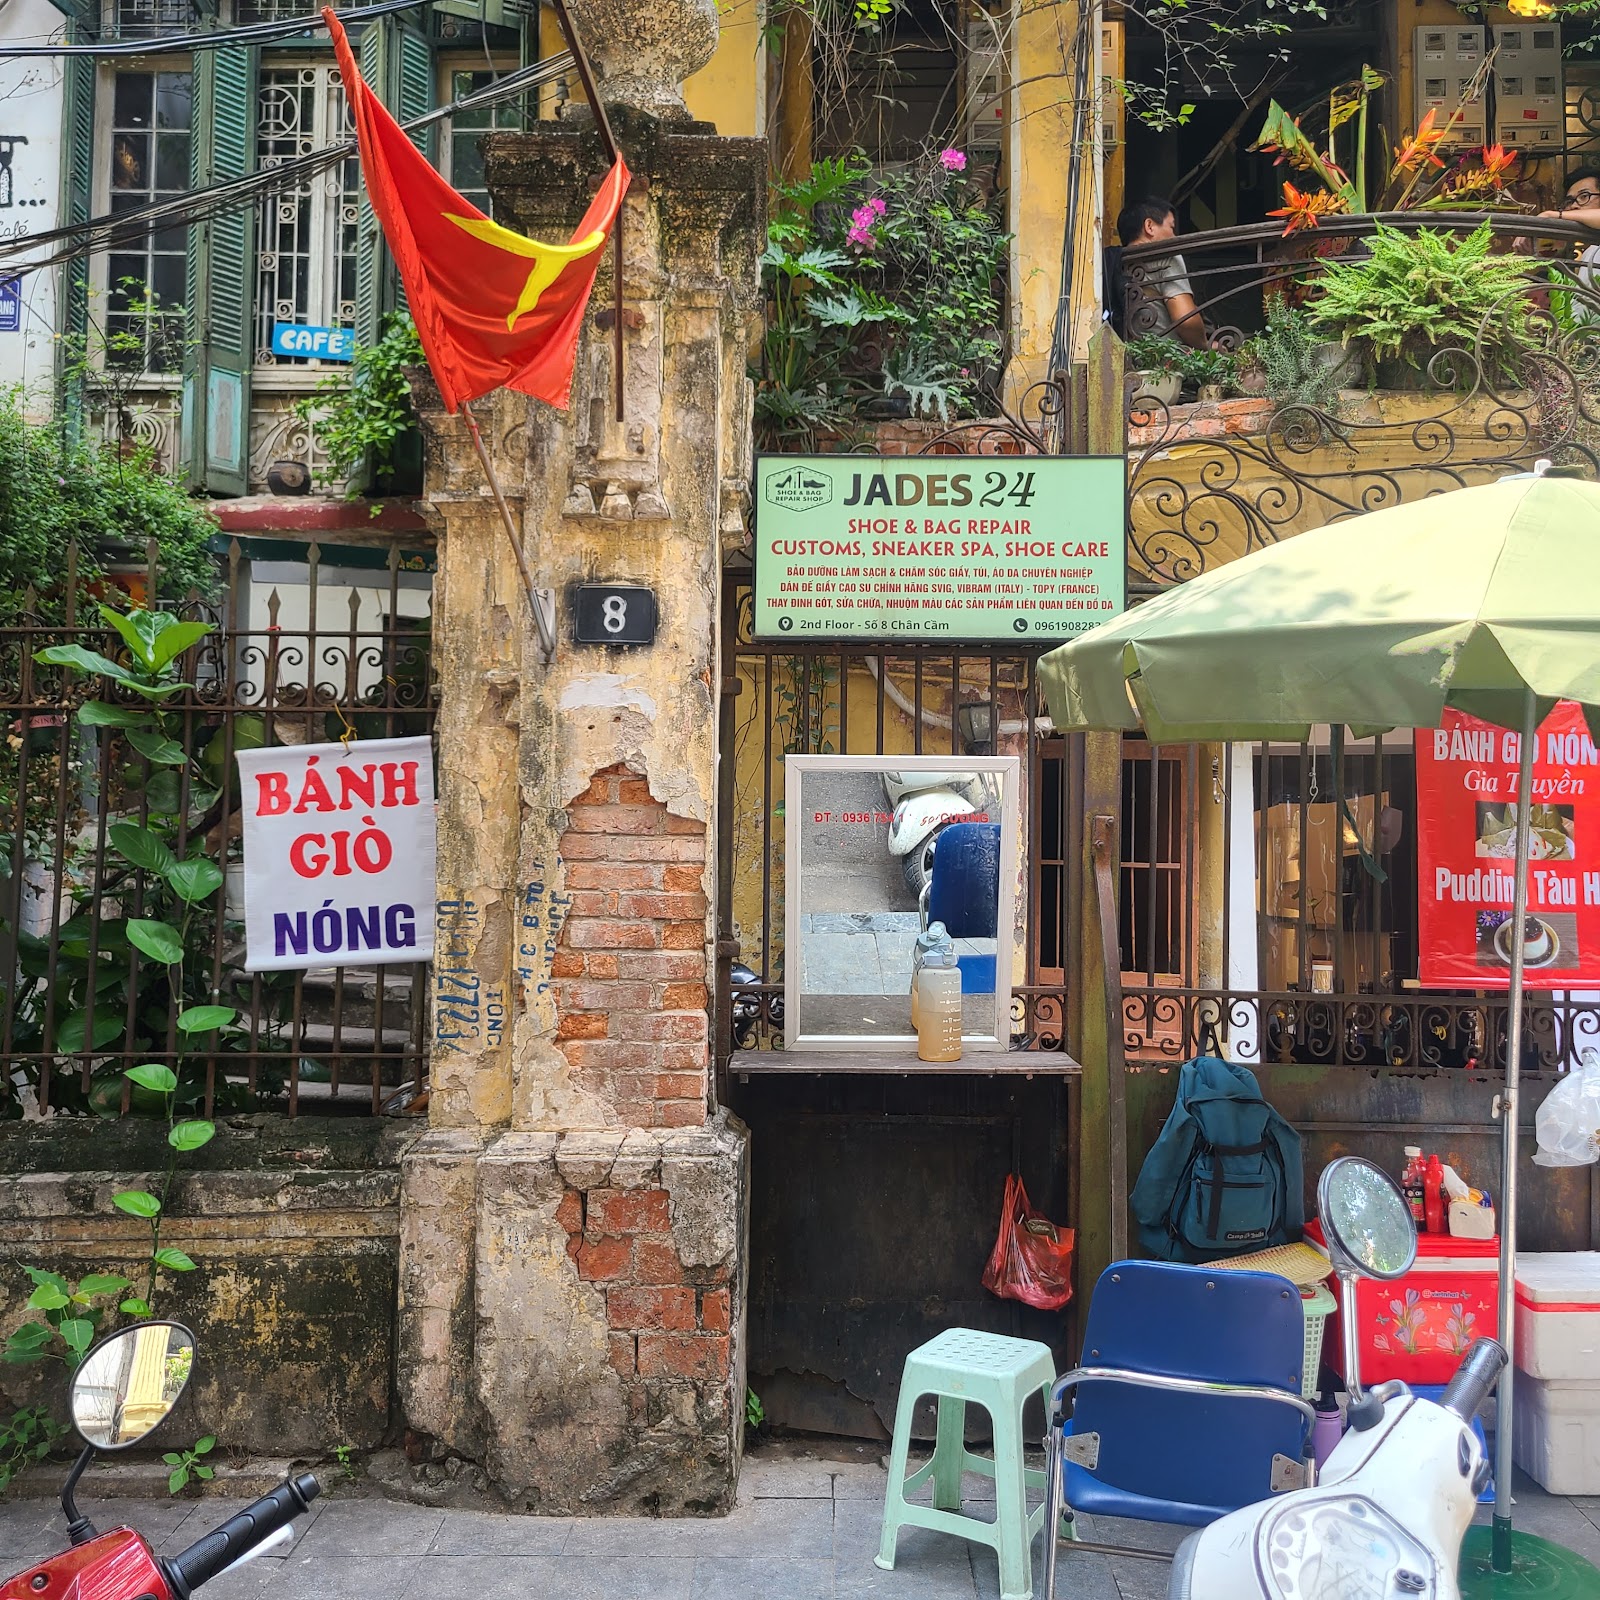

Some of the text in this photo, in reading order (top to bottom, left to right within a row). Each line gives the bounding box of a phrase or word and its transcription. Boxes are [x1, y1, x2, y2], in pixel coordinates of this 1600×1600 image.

[843, 471, 1036, 508] JADES 24
[848, 518, 1032, 535] SHOE & BAG REPAIR
[771, 539, 1109, 559] CUSTOMS, SNEAKER SPA, SHOE CARE
[787, 564, 804, 577] BẢO
[808, 565, 838, 577] DƯỠNG
[840, 566, 860, 577] LÀM
[863, 567, 887, 579] SẠCH
[889, 567, 896, 577] &
[899, 566, 926, 577] CHĂM
[929, 566, 946, 577] SÓC
[973, 566, 990, 578] TÚI,
[992, 567, 1005, 578] ÁO
[1007, 568, 1019, 578] DA
[1021, 567, 1057, 578] CHUYÊN
[1060, 567, 1093, 580] NGHIỆP
[780, 580, 799, 592] DÁN
[838, 582, 857, 593] CAO
[859, 583, 871, 593] SU
[873, 581, 900, 593] CHÍNH
[904, 582, 929, 593] HÃNG
[931, 583, 955, 594] SVIG,
[957, 583, 992, 593] VIBRAM
[994, 584, 1024, 595] (ITALY)
[1032, 584, 1055, 594] TOPY
[1058, 584, 1099, 595] (FRANCE)
[602, 595, 627, 633] 8
[766, 598, 788, 608] THAY
[791, 598, 812, 608] ĐINH
[836, 596, 854, 608] SỬA
[857, 597, 884, 609] CHỮA,
[886, 597, 919, 610] NHUỘM
[922, 597, 943, 609] MÀU
[945, 598, 963, 609] CÁC
[966, 597, 985, 609] SẢN
[987, 596, 1014, 609] PHẨM
[1016, 598, 1036, 609] LIÊN
[1039, 599, 1063, 610] QUAN
[1065, 597, 1083, 610] ĐẾN
[1101, 600, 1113, 610] DA
[800, 619, 822, 629] 2nd
[825, 619, 855, 630] Floor
[864, 618, 879, 630] Số
[881, 620, 888, 630] 8
[891, 619, 920, 630] Chân
[923, 619, 949, 630] Cầm
[1433, 722, 1494, 763] BÁNH
[255, 755, 420, 816] BÁNH
[1464, 769, 1585, 799] Gia Tuyền
[814, 812, 831, 823] ĐT
[842, 812, 870, 823] 0936
[289, 816, 393, 878] GIÒ
[1435, 866, 1528, 907] Puddin
[1533, 870, 1577, 905] Tàu
[273, 899, 416, 957] NÓNG
